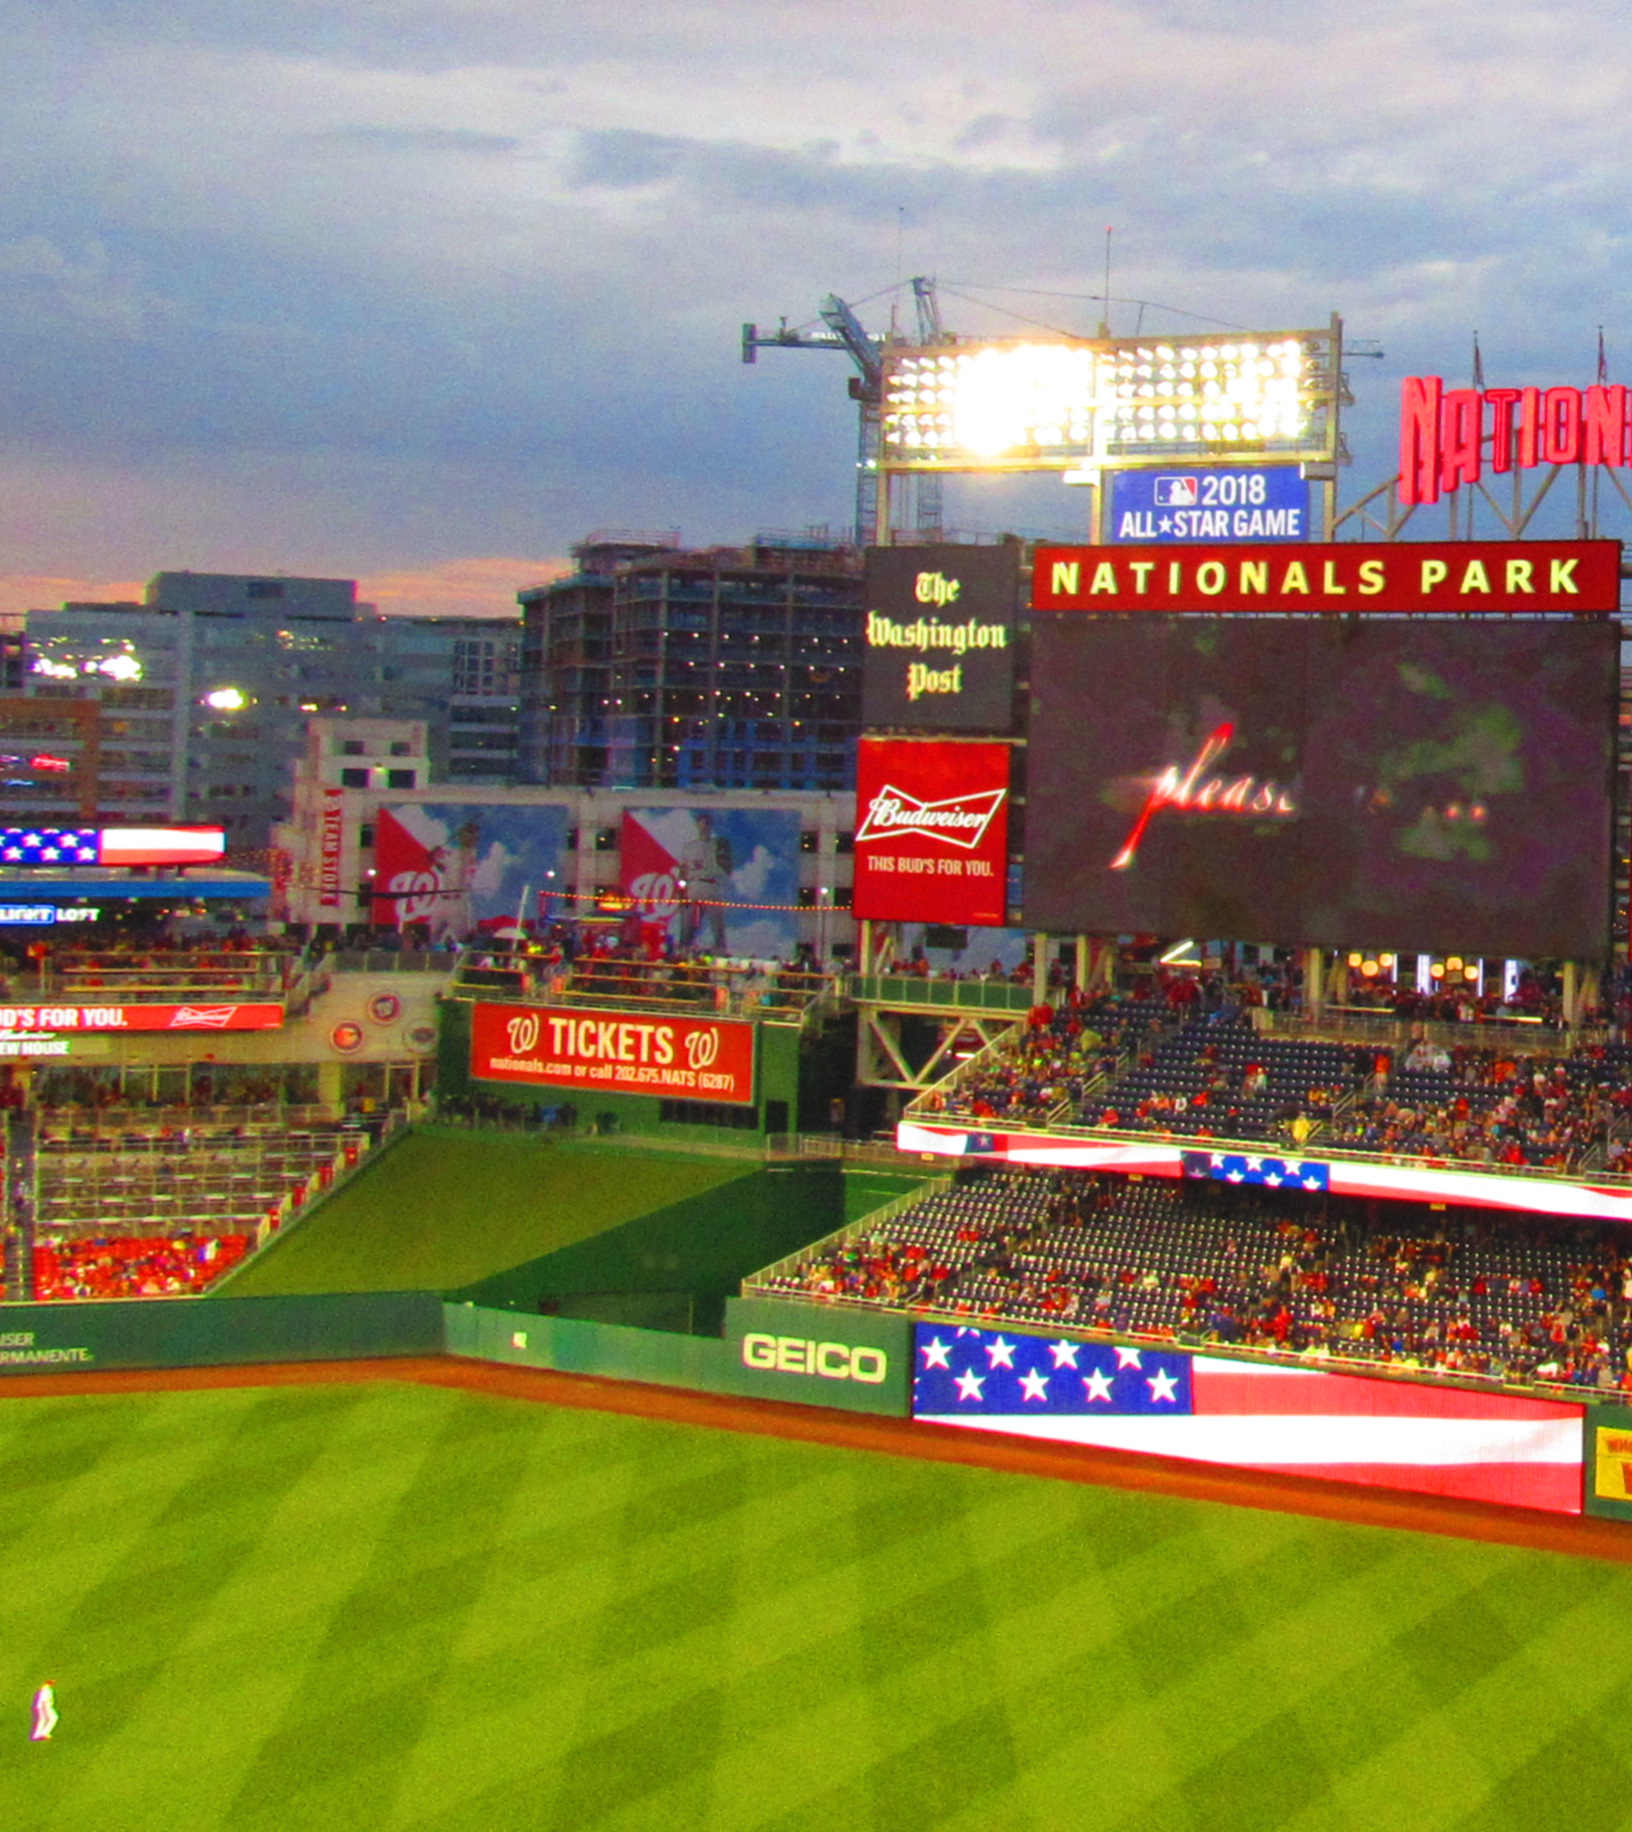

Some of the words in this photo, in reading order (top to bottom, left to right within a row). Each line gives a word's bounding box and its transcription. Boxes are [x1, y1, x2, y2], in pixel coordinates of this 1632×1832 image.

[1201, 475, 1266, 506] 2018
[1119, 511, 1157, 538] ALL
[1173, 510, 1229, 537] STAR
[1233, 509, 1300, 537] GAME
[915, 571, 961, 607] The
[1051, 561, 1385, 594] NATIONALS
[1420, 559, 1580, 593] PARK
[866, 610, 1008, 655] Washington
[906, 663, 962, 701] Post
[869, 799, 988, 828] Budweiser
[868, 856, 895, 871] THIS
[898, 857, 934, 874] BUD'S
[937, 859, 962, 875] FOR
[966, 860, 994, 877] YOU.
[56, 908, 101, 922] LOFT
[39, 1008, 79, 1027] FOR
[83, 1008, 128, 1027] YOU.
[22, 1041, 70, 1055] HOUSE
[548, 1017, 674, 1065] TICKETS
[490, 1057, 571, 1076] nationals.com
[574, 1064, 587, 1077] or
[589, 1065, 612, 1079] call
[615, 1065, 695, 1088] 202.675.NATS
[698, 1071, 735, 1093] (6287)
[742, 1332, 887, 1384] GEICO
